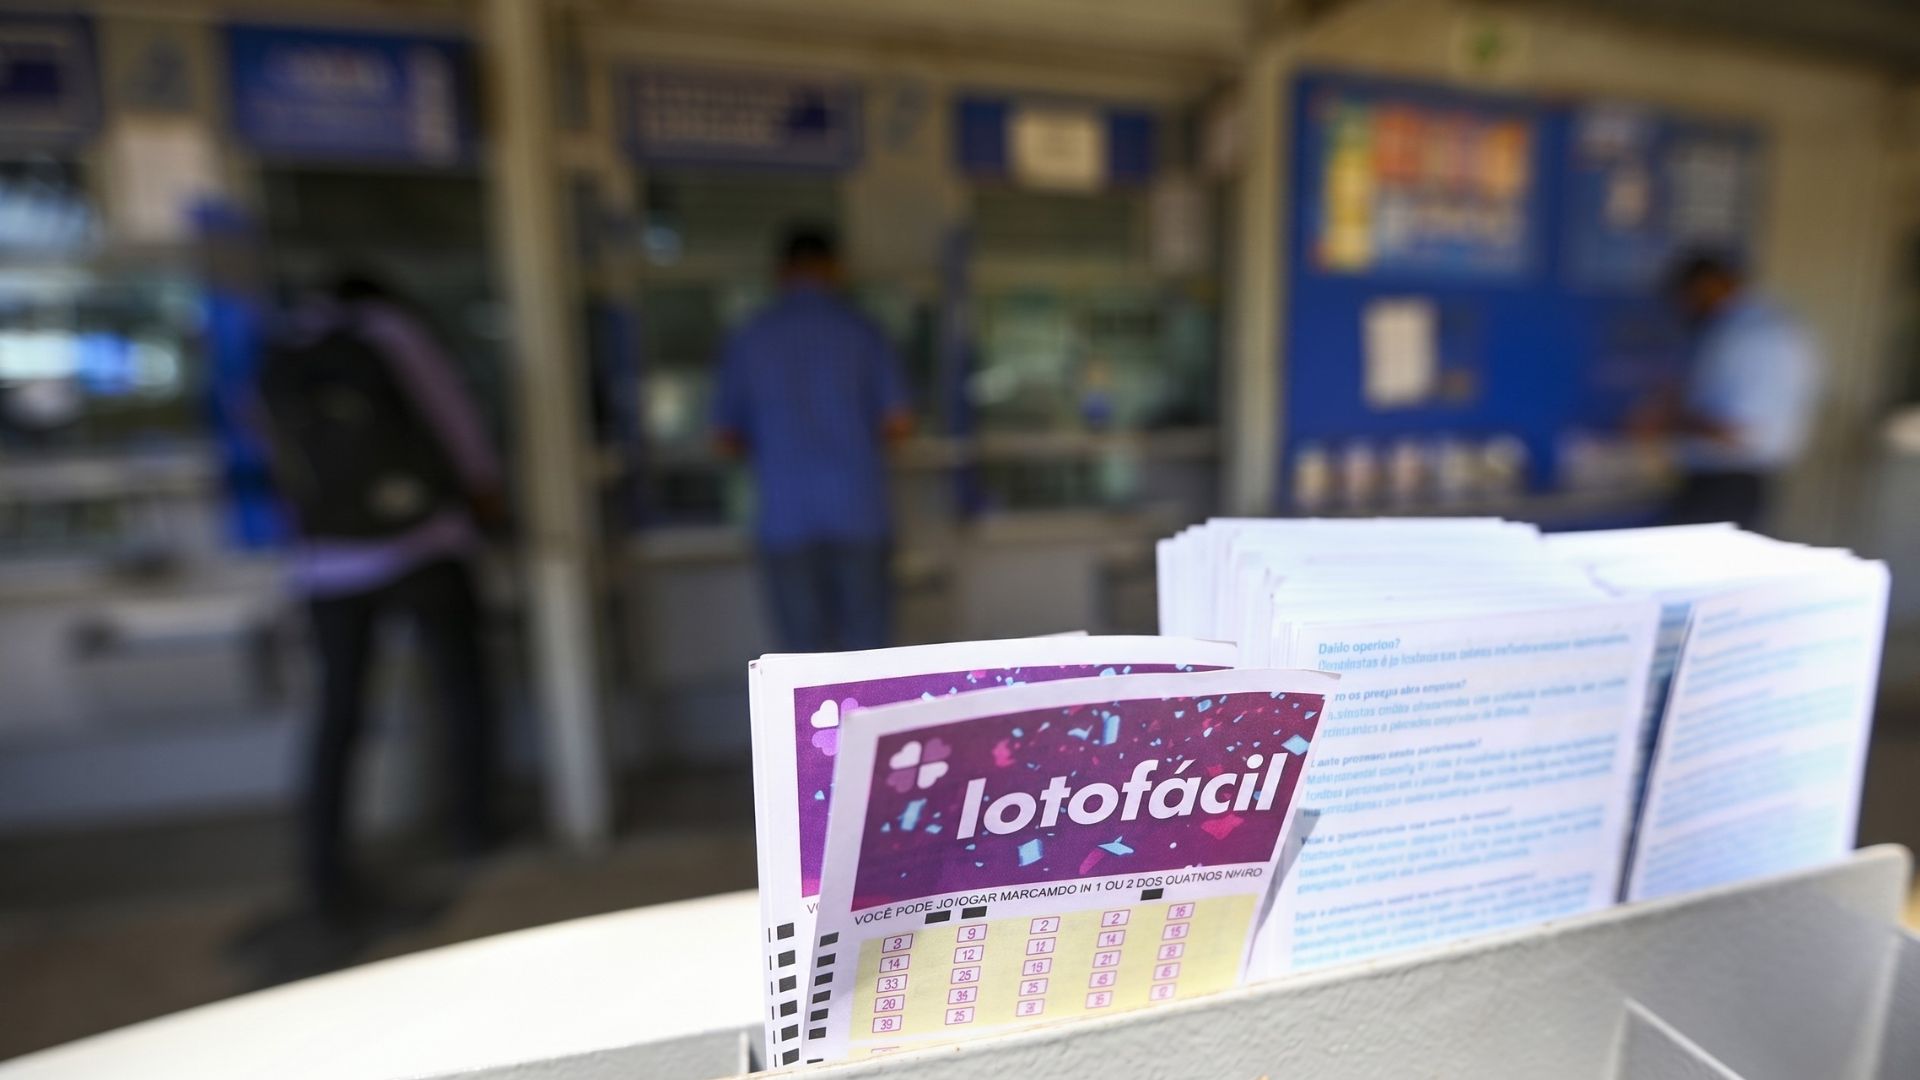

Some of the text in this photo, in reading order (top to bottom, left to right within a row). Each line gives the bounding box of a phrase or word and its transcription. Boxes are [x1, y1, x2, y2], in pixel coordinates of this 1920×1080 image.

[957, 752, 1288, 840] lotofácil
[854, 907, 892, 926] VOCÊ
[895, 900, 933, 918] PODE
[1105, 879, 1124, 891] OU
[1126, 878, 1134, 889] 2
[1136, 876, 1163, 888] DOS
[968, 928, 976, 940] 9
[1040, 920, 1049, 932] 2
[1112, 913, 1120, 924] 2
[884, 978, 898, 990] 33
[958, 970, 971, 981] 25
[1100, 954, 1112, 965] 21
[888, 958, 900, 970] 14
[962, 949, 974, 960] 12
[882, 998, 896, 1010] 20
[880, 1018, 892, 1030] 39
